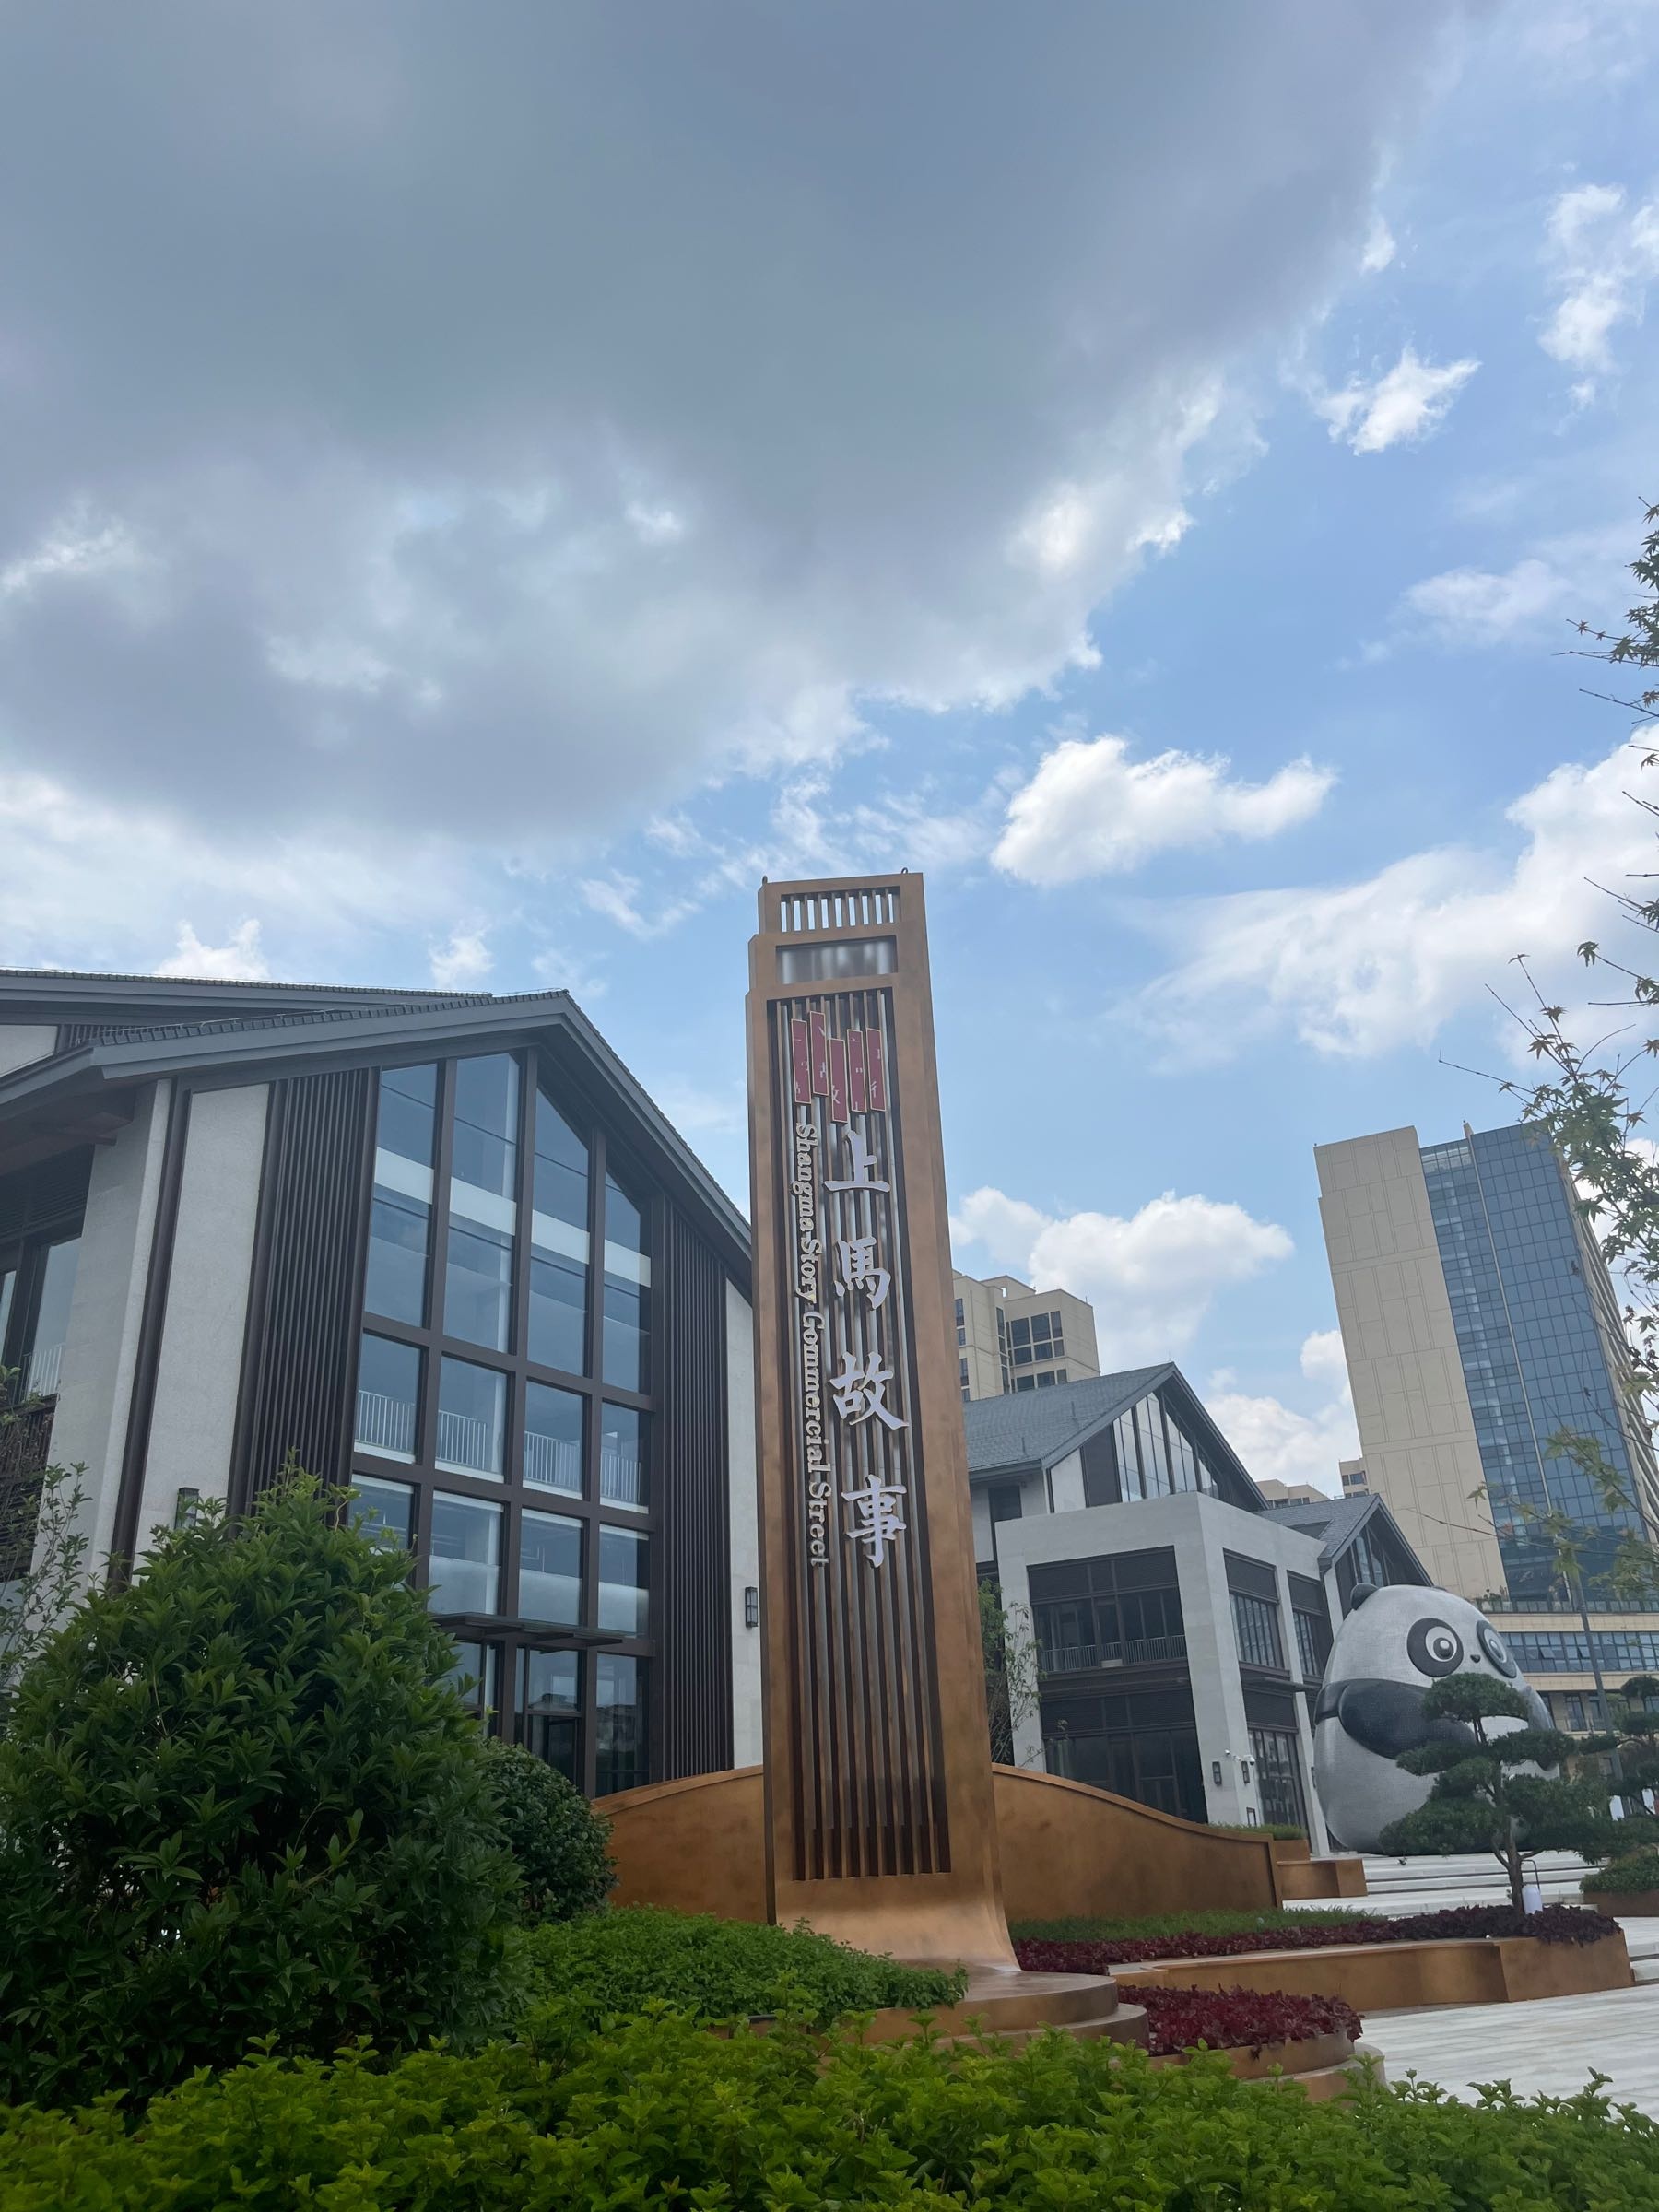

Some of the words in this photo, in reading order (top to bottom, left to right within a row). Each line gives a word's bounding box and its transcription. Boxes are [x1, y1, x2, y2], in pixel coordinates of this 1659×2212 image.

[792, 1122, 818, 1232] Shangma
[795, 1238, 822, 1304] Story
[803, 1312, 831, 1473] Commercial
[824, 1130, 909, 1568] 上馬故事
[809, 1481, 831, 1567] Street
